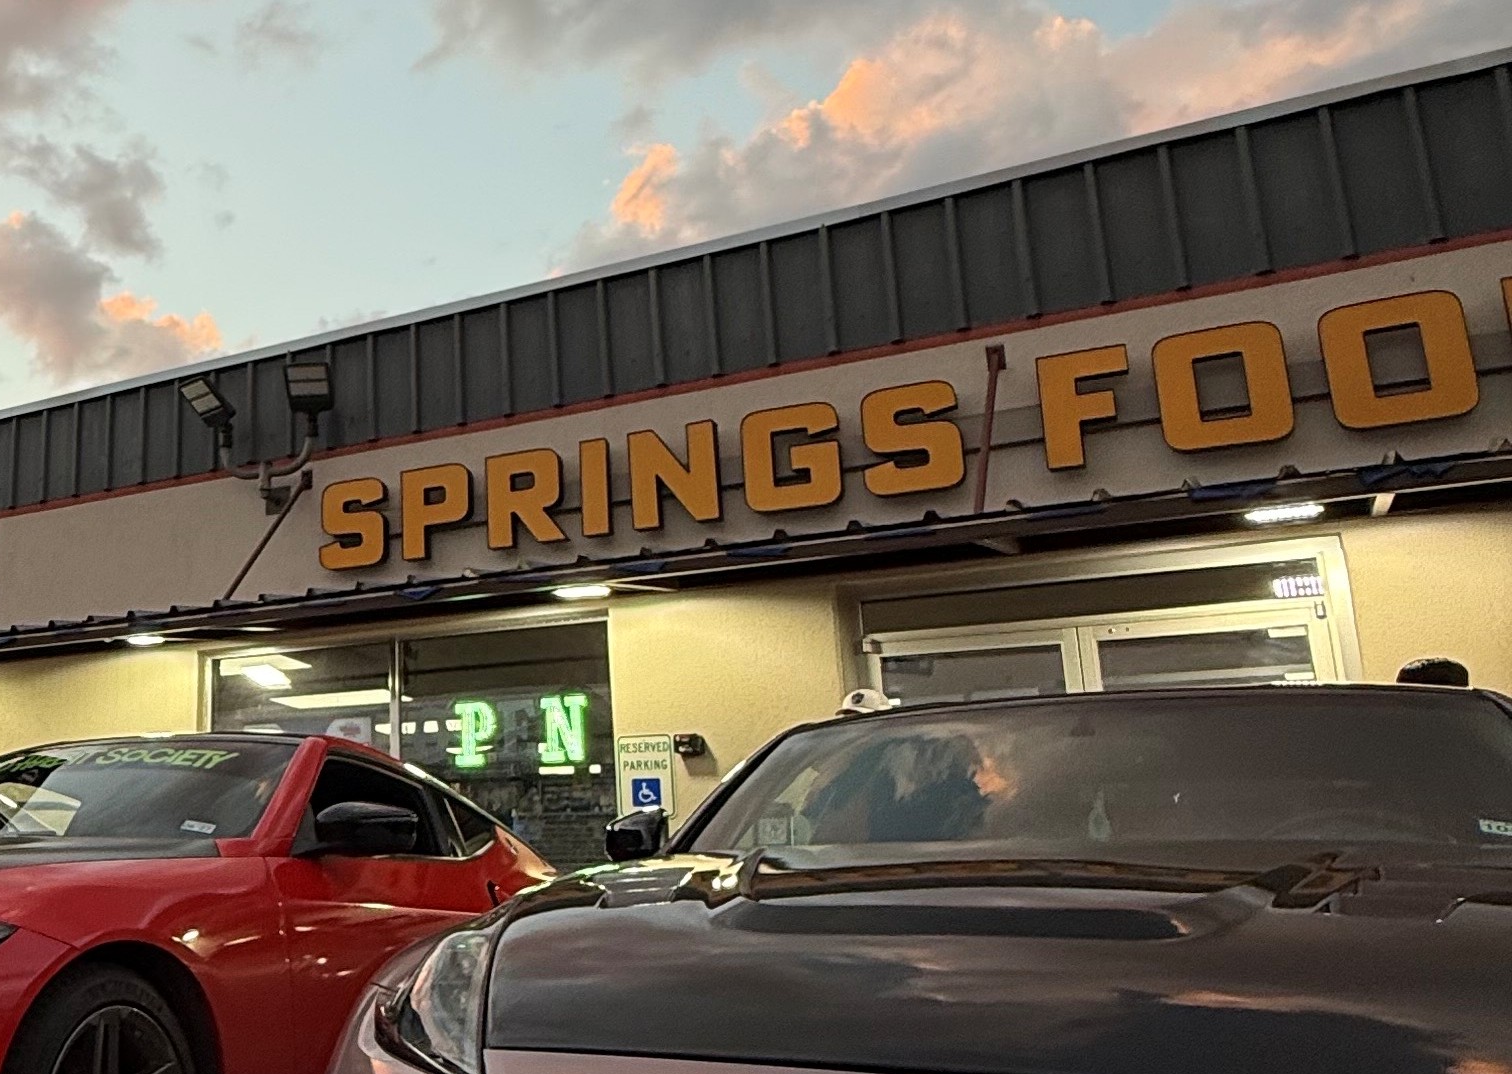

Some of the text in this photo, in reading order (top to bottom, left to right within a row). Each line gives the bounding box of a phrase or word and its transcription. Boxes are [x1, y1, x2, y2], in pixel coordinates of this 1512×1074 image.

[319, 276, 1512, 572] SPRINGS FOO
[619, 740, 669, 753] RESERVED
[94, 747, 240, 770] SOCIETY
[622, 759, 668, 771] PARKING
